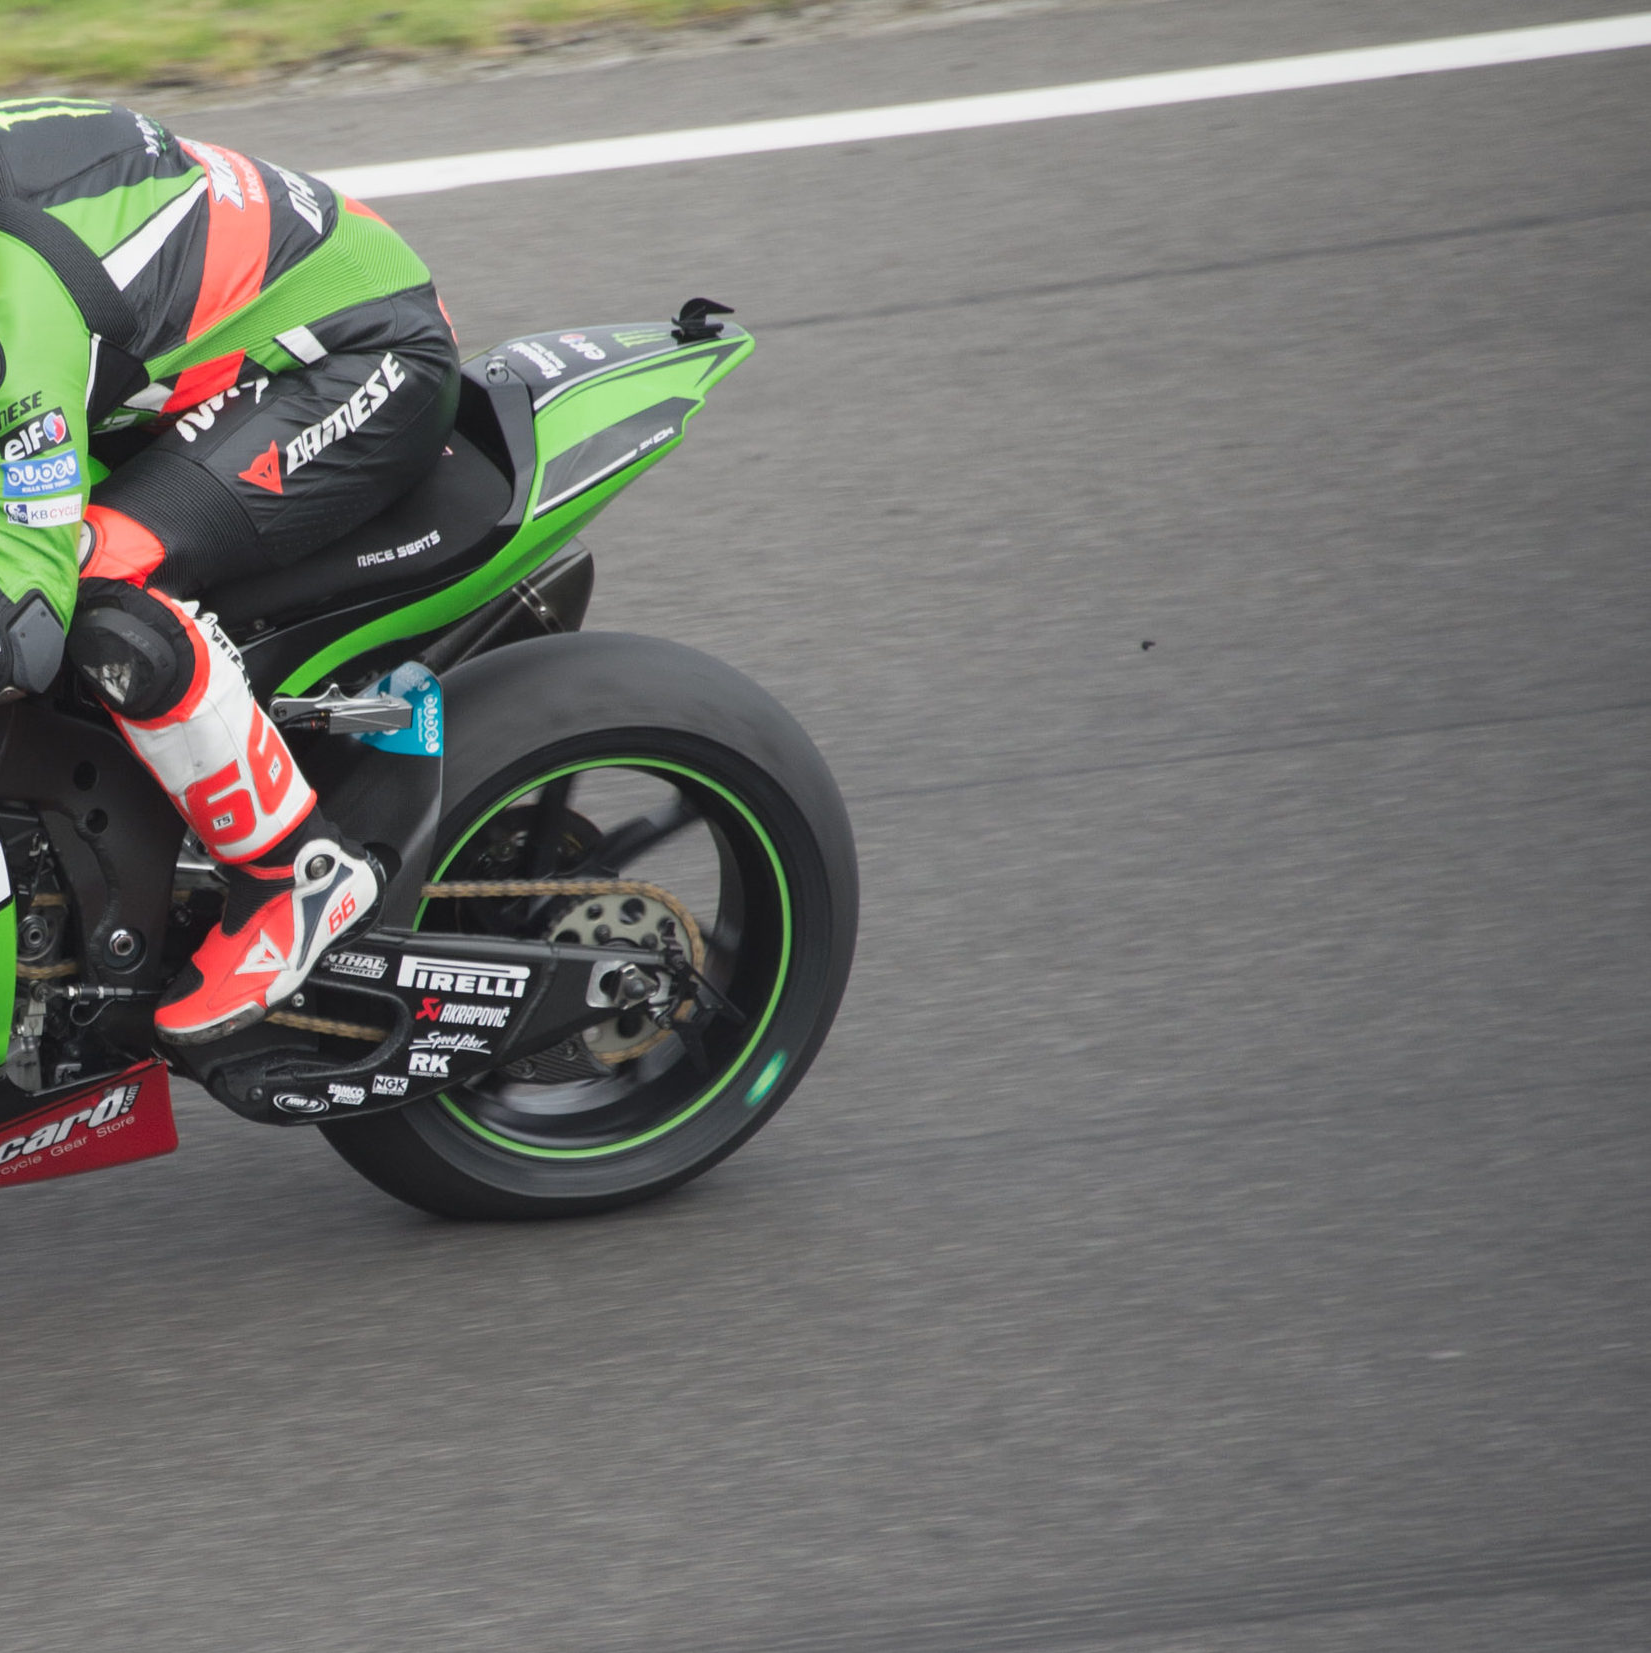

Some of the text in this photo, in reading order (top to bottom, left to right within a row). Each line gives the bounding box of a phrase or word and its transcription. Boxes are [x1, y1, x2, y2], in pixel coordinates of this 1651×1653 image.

[4, 421, 44, 462] elf
[356, 530, 441, 568] RACE SEATS
[328, 891, 356, 936] 66
[397, 955, 531, 998] PIRELLI
[408, 1052, 451, 1074] RK
[373, 1077, 408, 1091] NGK
[50, 1135, 88, 1158] Gear
[96, 1115, 136, 1139] Store
